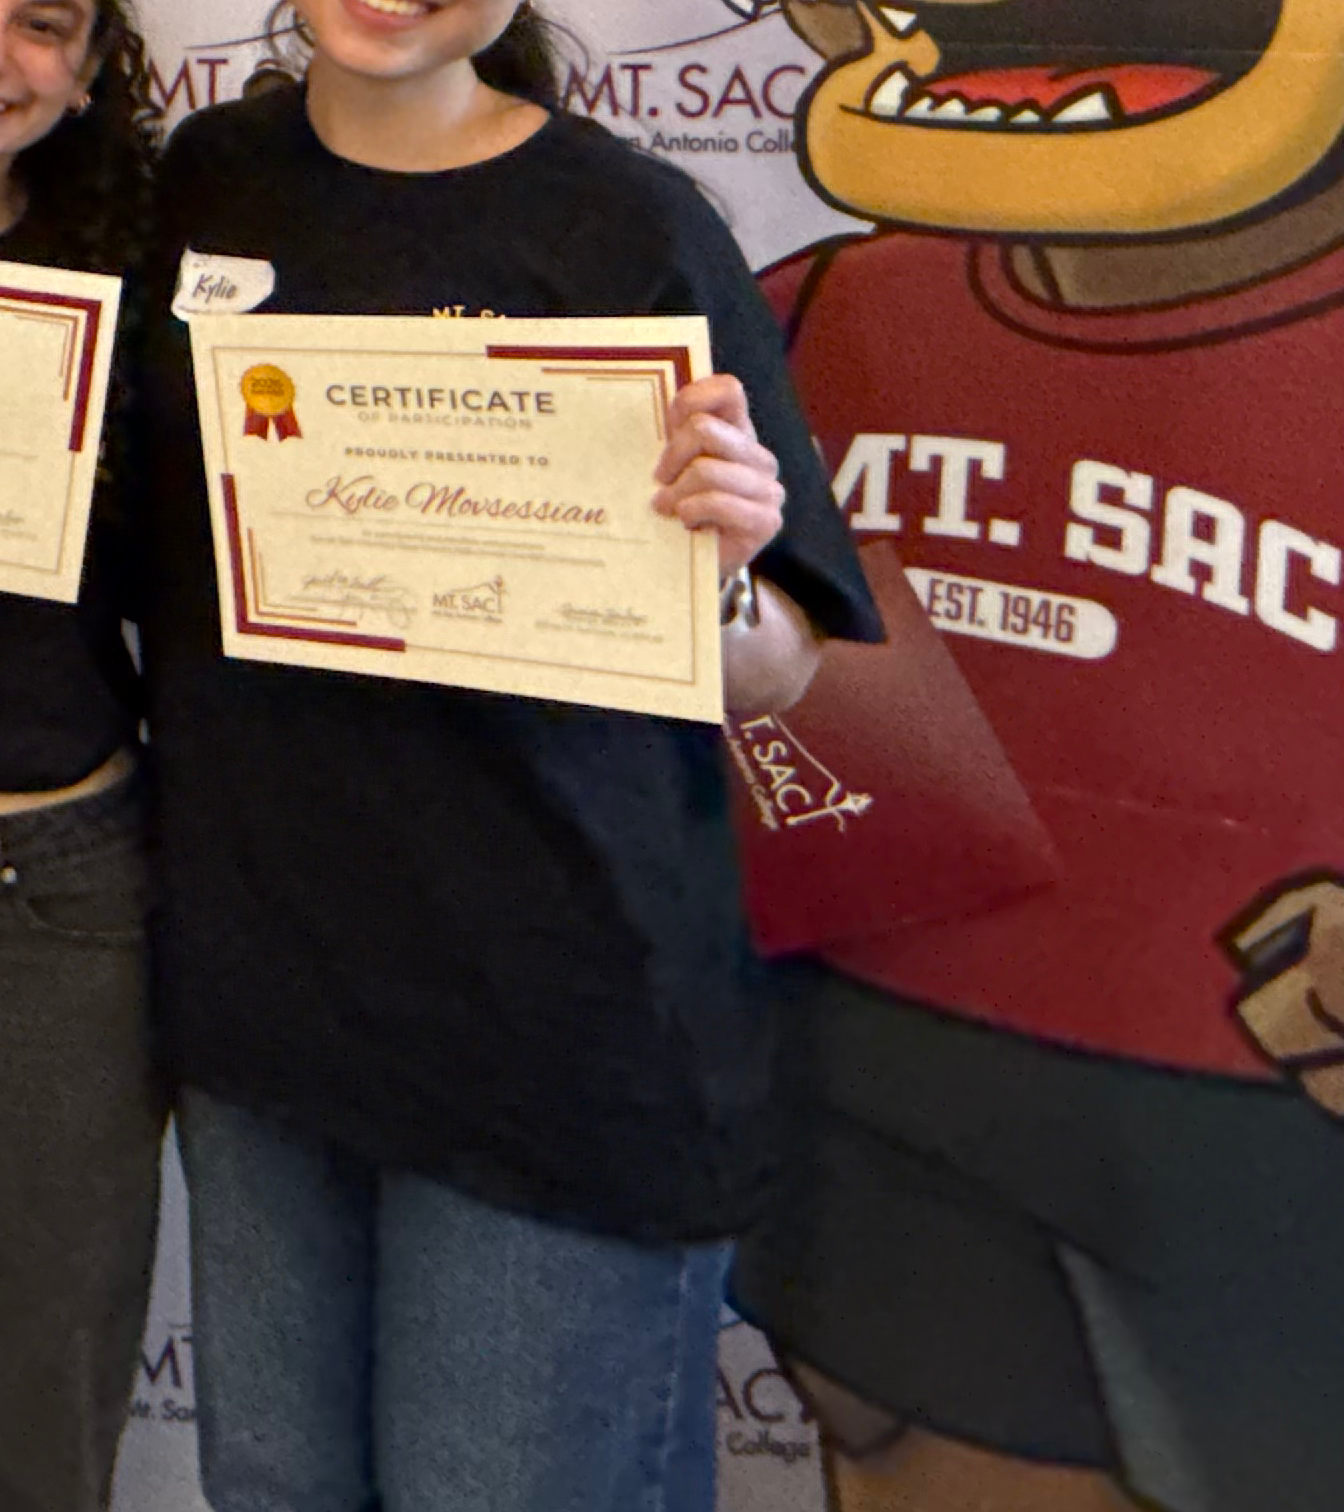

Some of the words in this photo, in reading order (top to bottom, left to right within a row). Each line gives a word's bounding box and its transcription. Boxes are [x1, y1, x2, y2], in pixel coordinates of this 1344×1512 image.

[148, 56, 229, 110] MT
[563, 62, 659, 118] MT.
[676, 62, 806, 119] SAC
[650, 131, 739, 153] Antonio
[192, 273, 238, 304] Kylie
[325, 384, 556, 414] CERTIFICATE
[344, 446, 418, 460] PROUDLY
[424, 449, 520, 466] PRESENTED
[527, 455, 549, 467] TO
[305, 475, 400, 515] Kylie
[404, 482, 607, 526] Movsessian
[1064, 459, 1342, 653] SAC
[926, 577, 987, 629] EST.
[998, 588, 1077, 644] 1946
[752, 740, 813, 813] SAC
